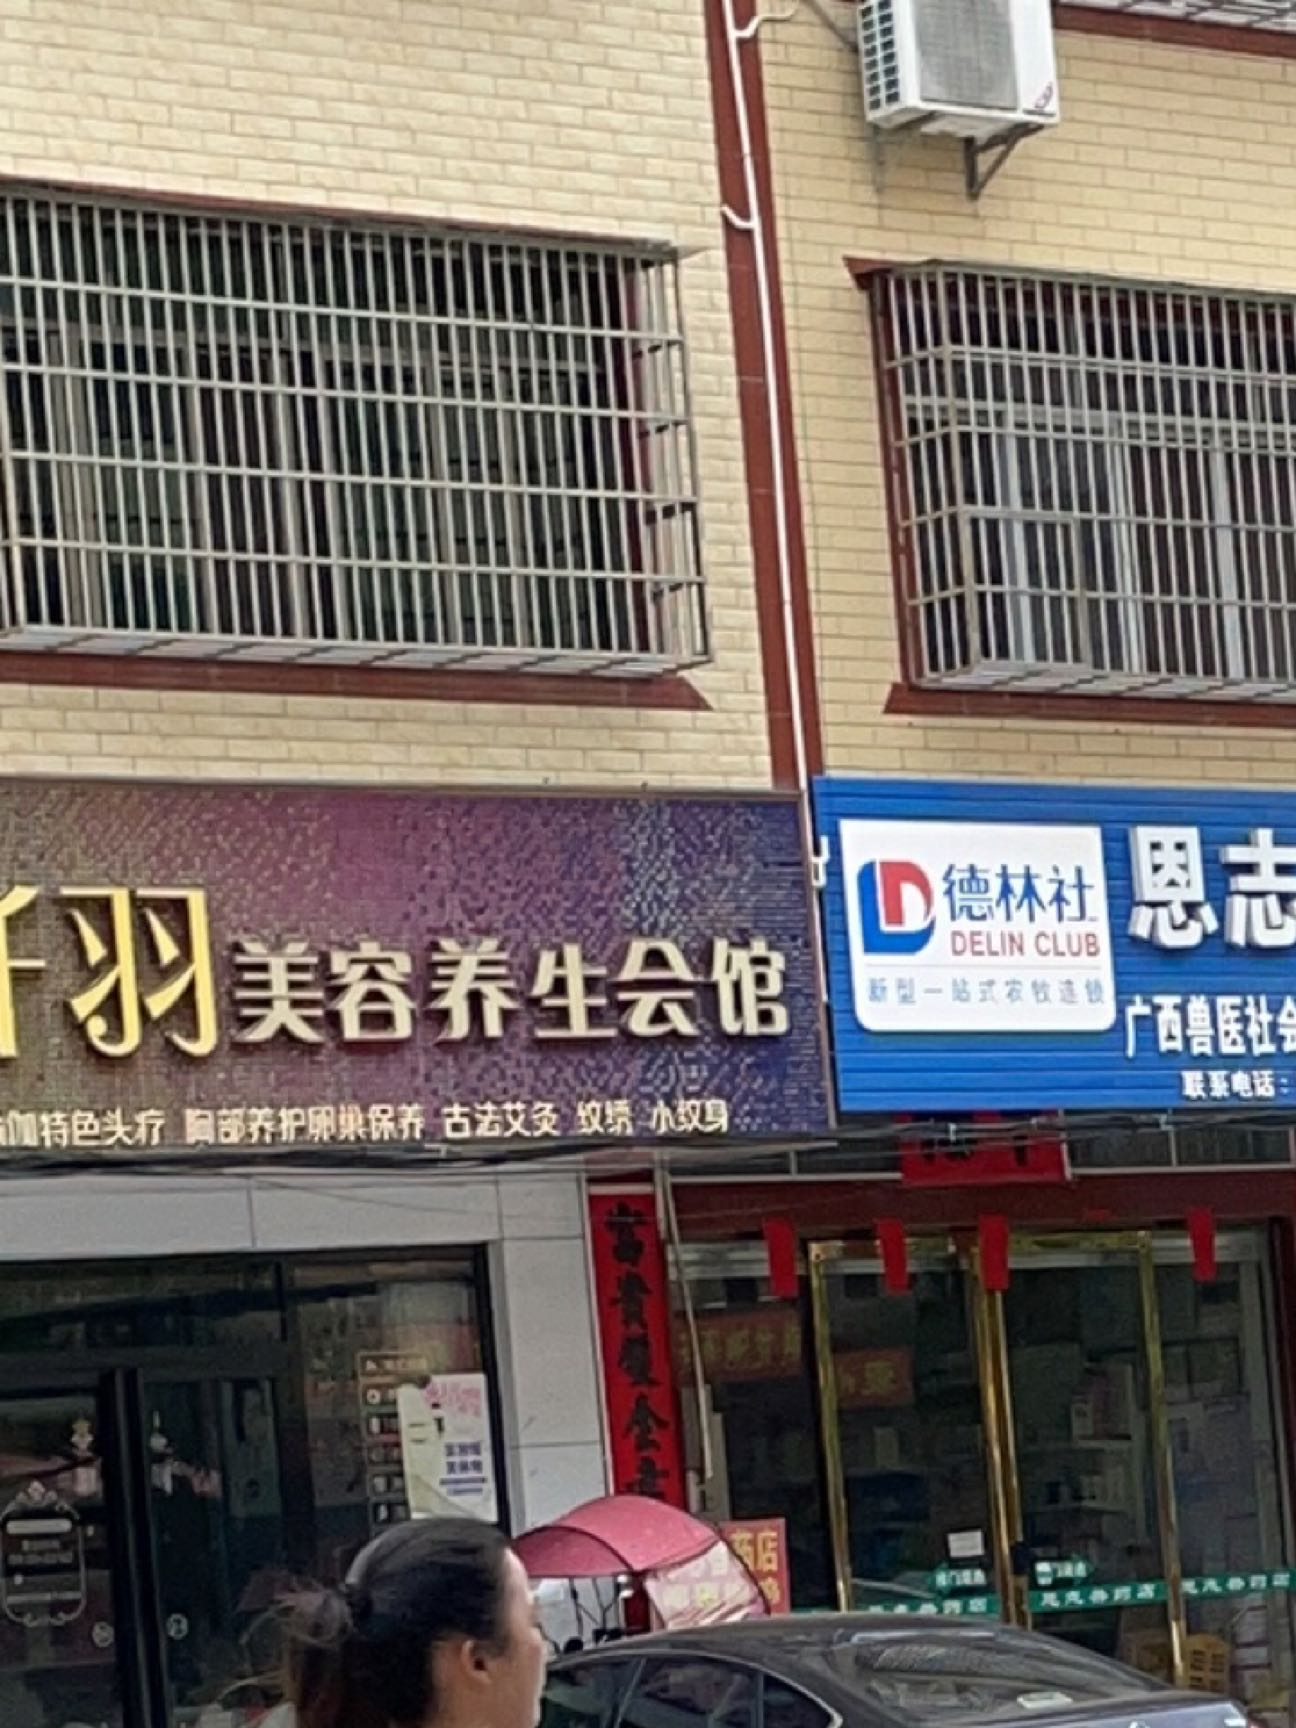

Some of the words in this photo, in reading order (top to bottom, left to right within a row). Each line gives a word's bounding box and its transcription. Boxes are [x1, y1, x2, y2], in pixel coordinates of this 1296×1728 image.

[942, 864, 1098, 923] 德林社
[950, 930, 1024, 956] DELIN
[1034, 931, 1100, 957] CLUB
[234, 936, 791, 1043] 美容养生会馆
[0, 1108, 166, 1147] 伽特色头疗
